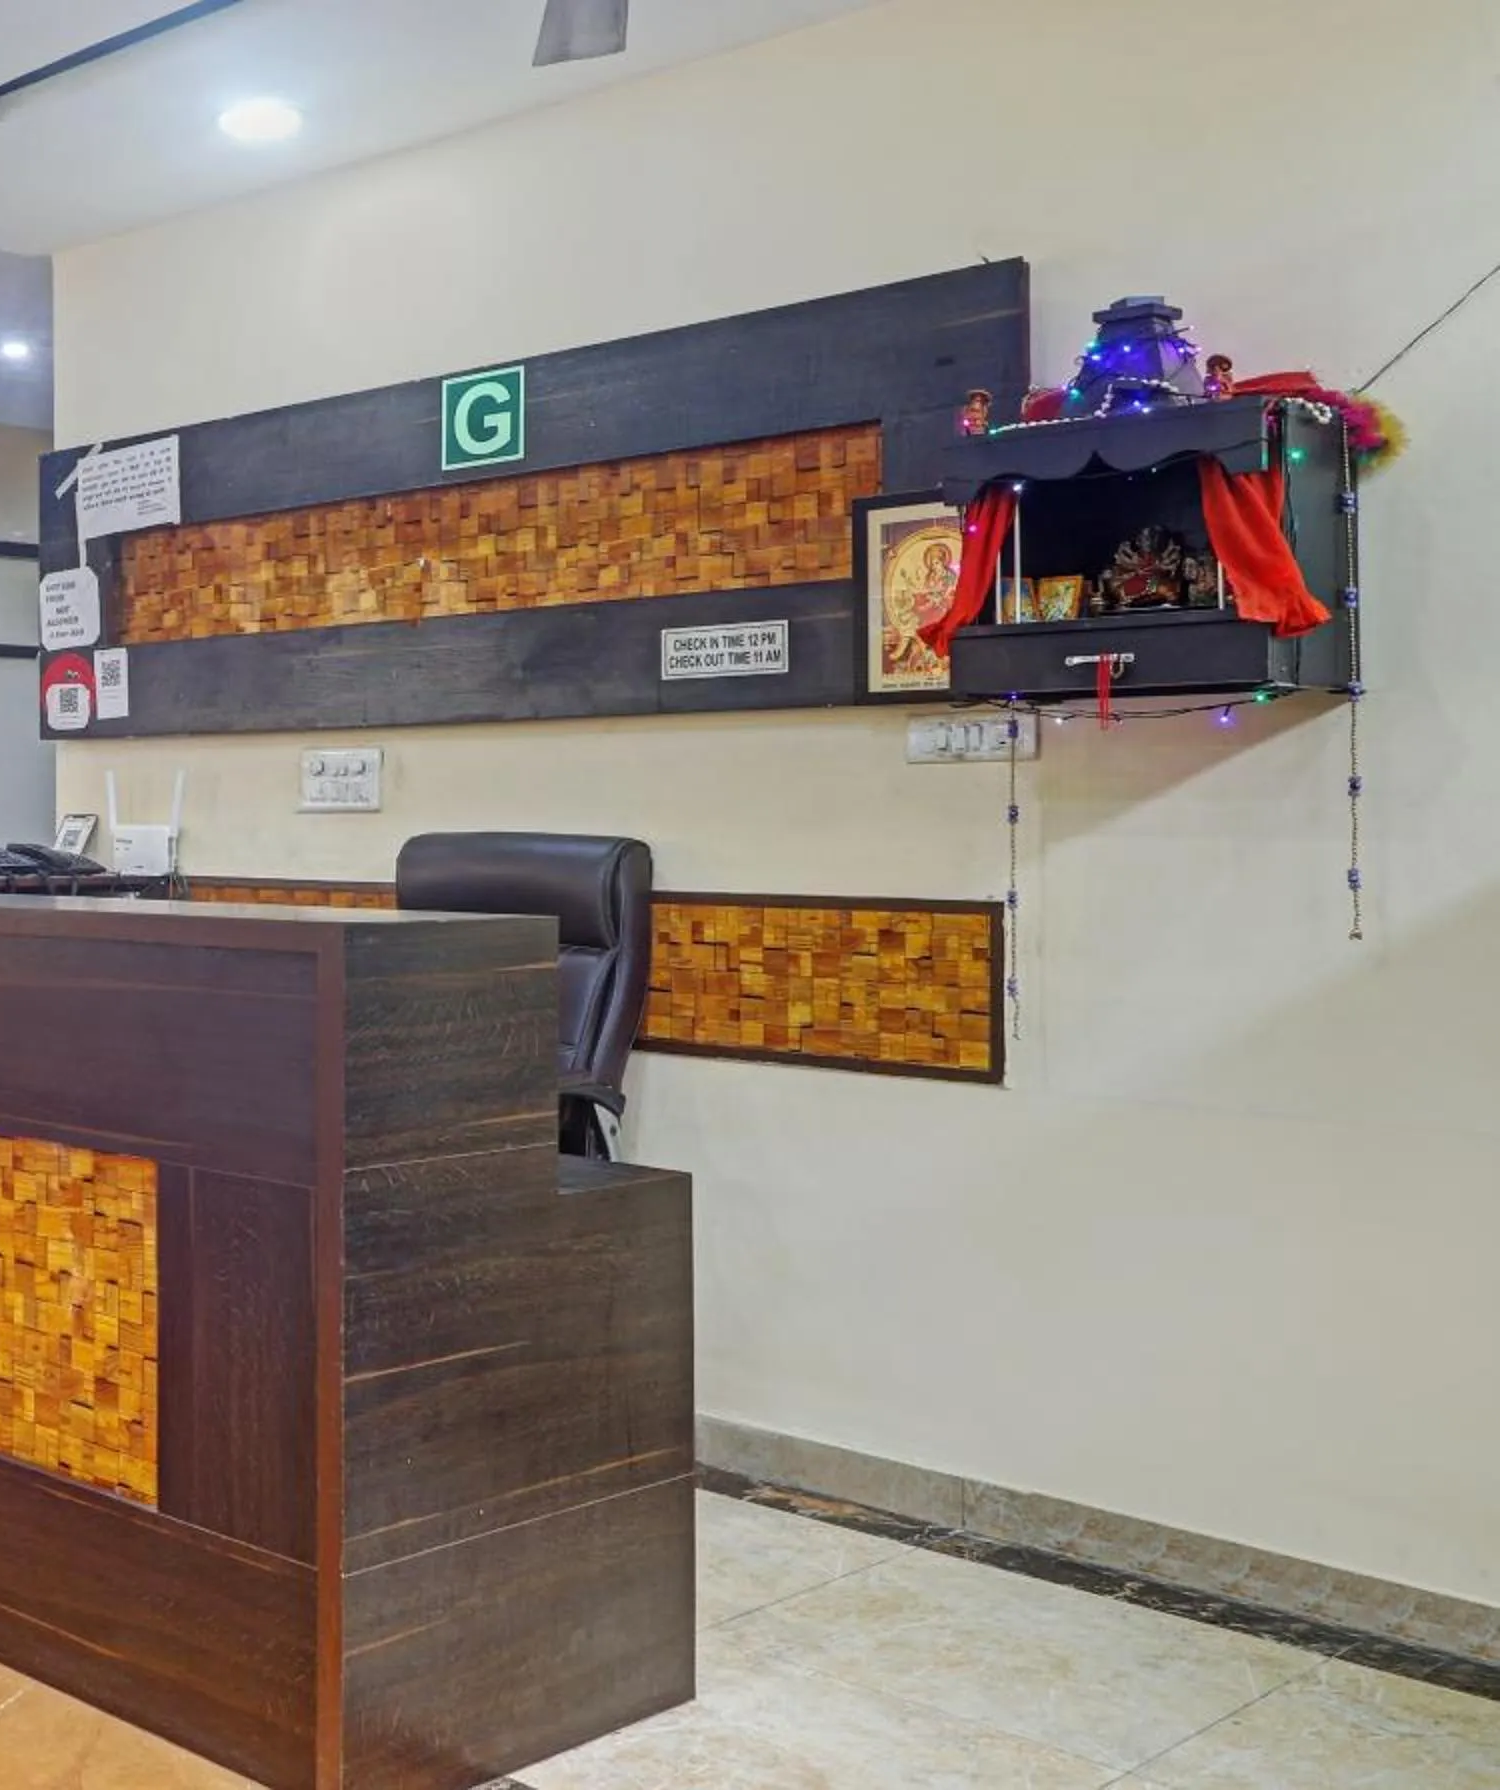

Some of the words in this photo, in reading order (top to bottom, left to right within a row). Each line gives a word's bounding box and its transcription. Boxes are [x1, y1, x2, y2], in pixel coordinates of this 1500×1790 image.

[454, 381, 512, 455] G
[673, 637, 707, 652] CHECK
[709, 636, 719, 649] IN
[721, 633, 745, 649] TIME
[747, 633, 759, 647] 12
[760, 631, 777, 645] PM
[668, 654, 703, 669] CHECK
[704, 652, 725, 667] OUT
[728, 651, 751, 665] TIME
[753, 651, 763, 663] 11
[765, 649, 781, 662] AM
